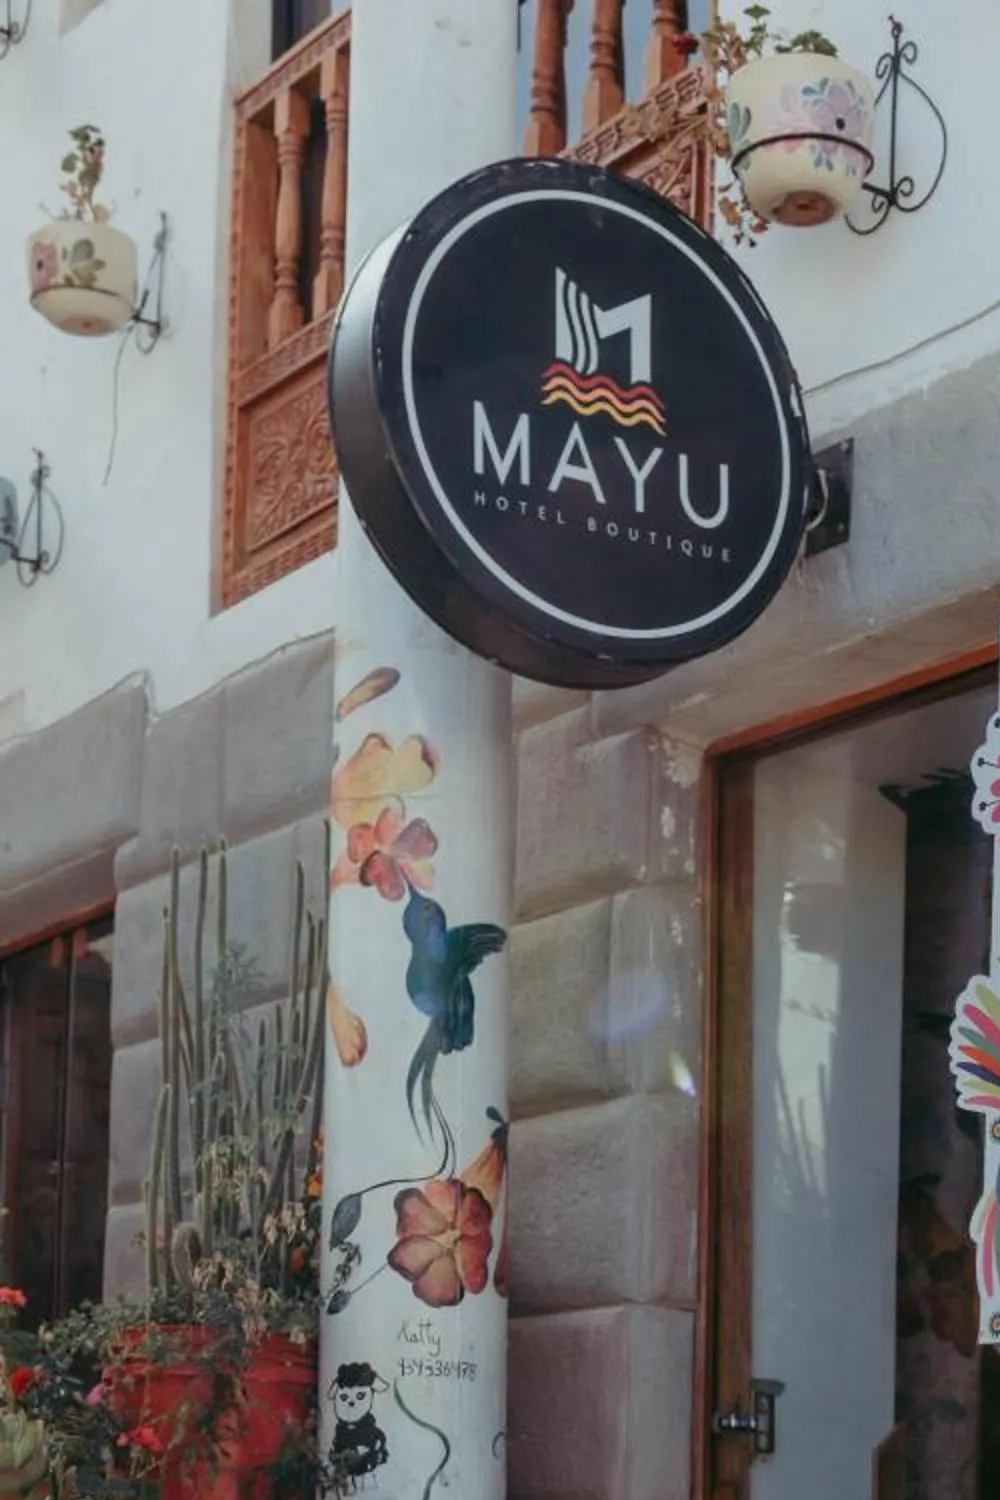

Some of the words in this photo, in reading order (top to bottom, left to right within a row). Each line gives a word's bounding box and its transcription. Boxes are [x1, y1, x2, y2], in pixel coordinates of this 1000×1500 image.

[473, 400, 729, 530] MAYU
[474, 490, 567, 525] HOTEL
[587, 516, 732, 563] BOUTIQUE
